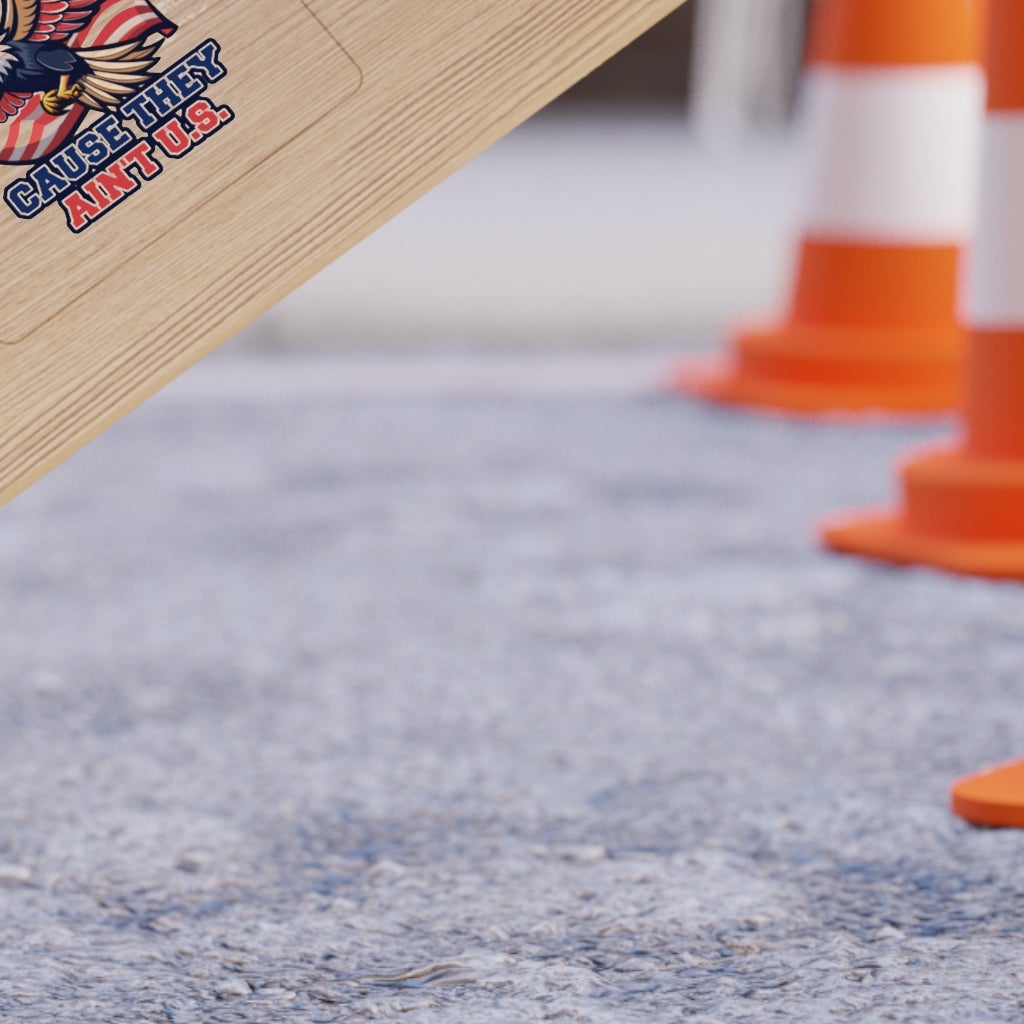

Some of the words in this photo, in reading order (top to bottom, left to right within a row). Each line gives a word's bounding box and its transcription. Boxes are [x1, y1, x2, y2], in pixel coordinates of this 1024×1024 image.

[6, 114, 133, 217] CAUSE
[121, 41, 225, 129] THEY
[58, 141, 160, 231] AIN'T
[153, 98, 232, 158] U.S.
